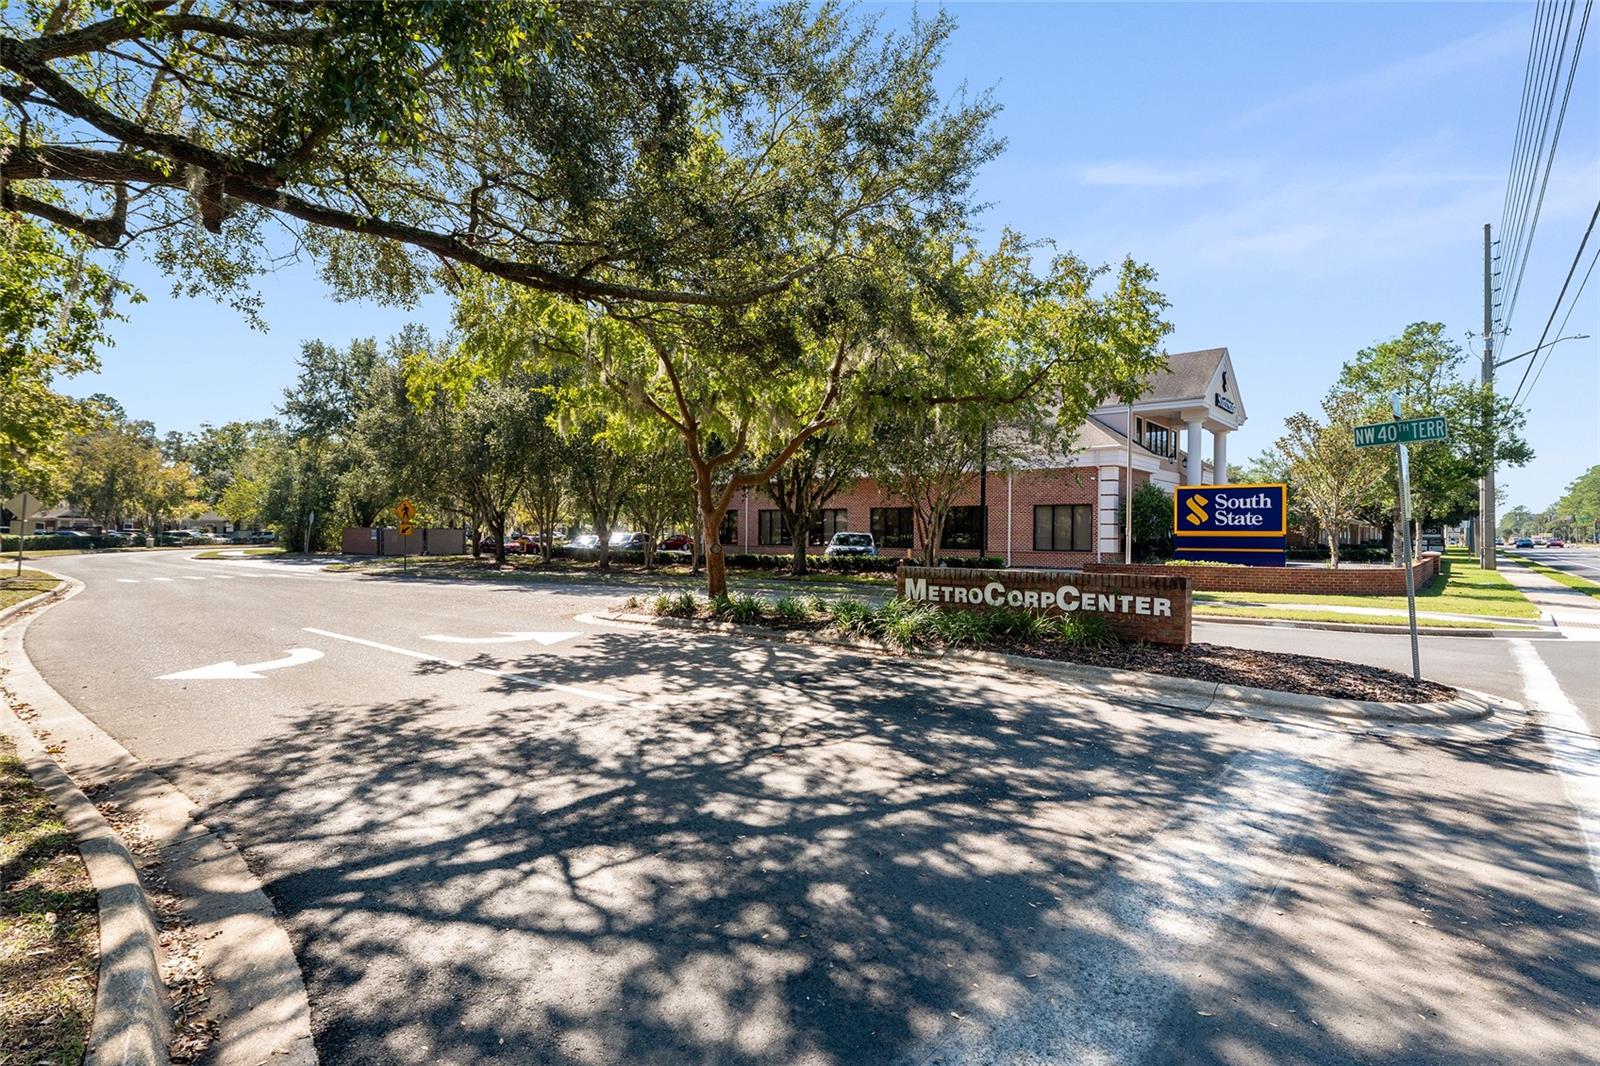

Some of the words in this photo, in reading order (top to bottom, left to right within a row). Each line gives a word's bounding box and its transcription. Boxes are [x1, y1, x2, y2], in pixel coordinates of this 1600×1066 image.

[1355, 427, 1374, 445] NW
[1377, 423, 1409, 442] 40TH
[1411, 420, 1445, 439] TERR
[1214, 493, 1272, 510] South
[1214, 510, 1263, 526] State
